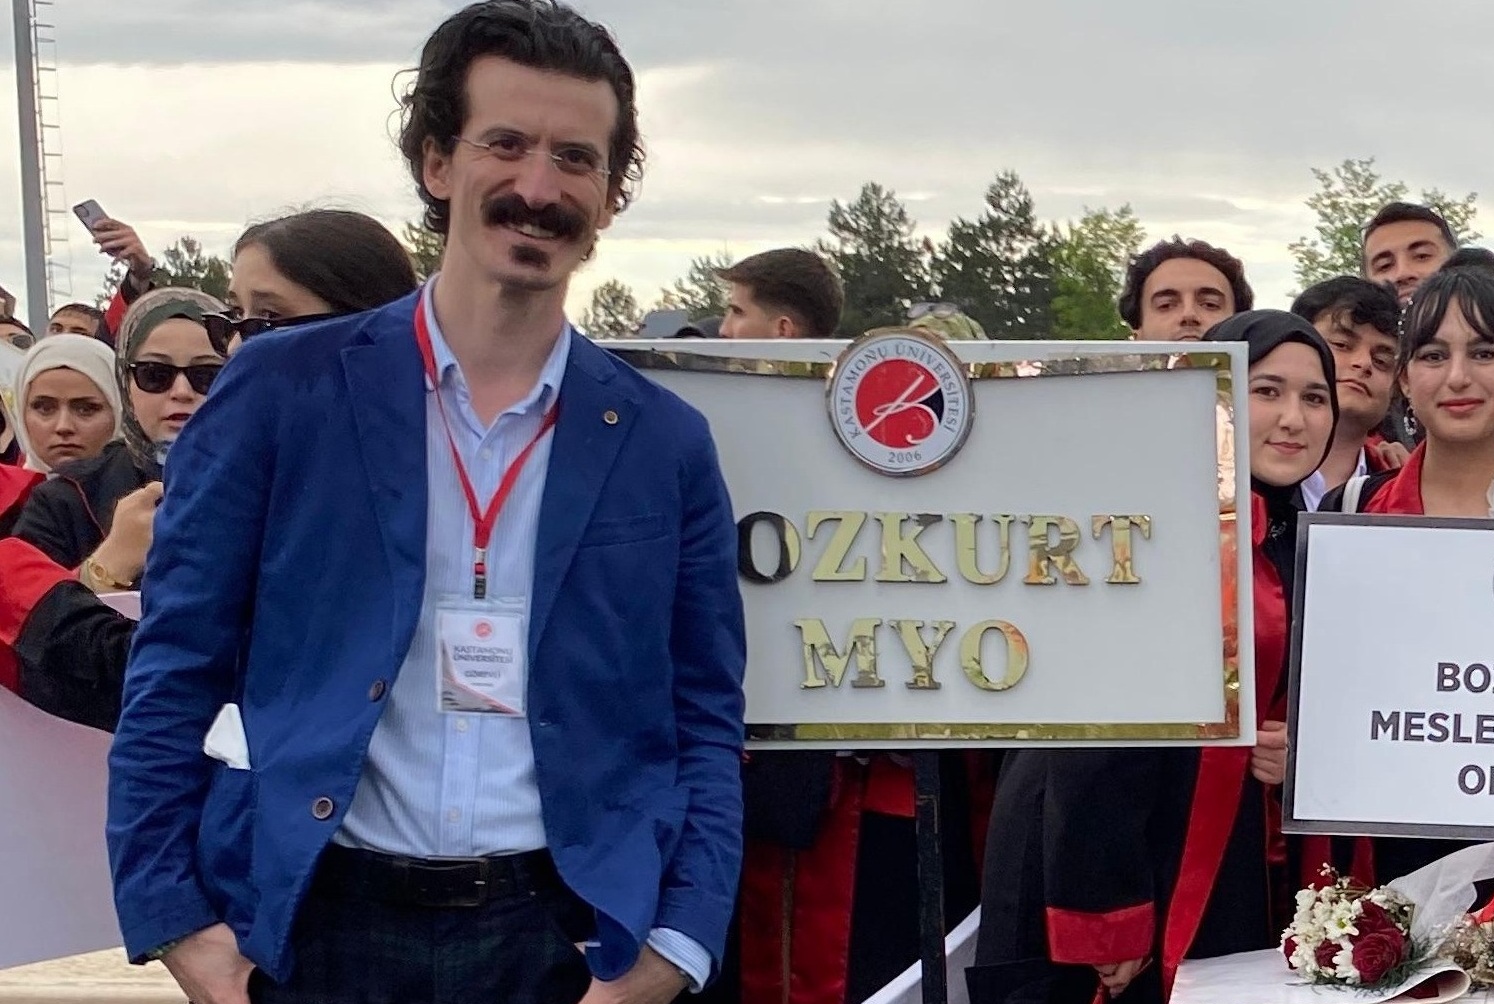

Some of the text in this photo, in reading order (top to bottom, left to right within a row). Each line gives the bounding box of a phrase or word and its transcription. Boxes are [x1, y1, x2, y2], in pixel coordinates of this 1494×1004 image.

[841, 347, 888, 439] KASTAMONU
[887, 451, 922, 463] 2006
[737, 511, 1152, 585] OZKURT
[793, 617, 1030, 692] MYO
